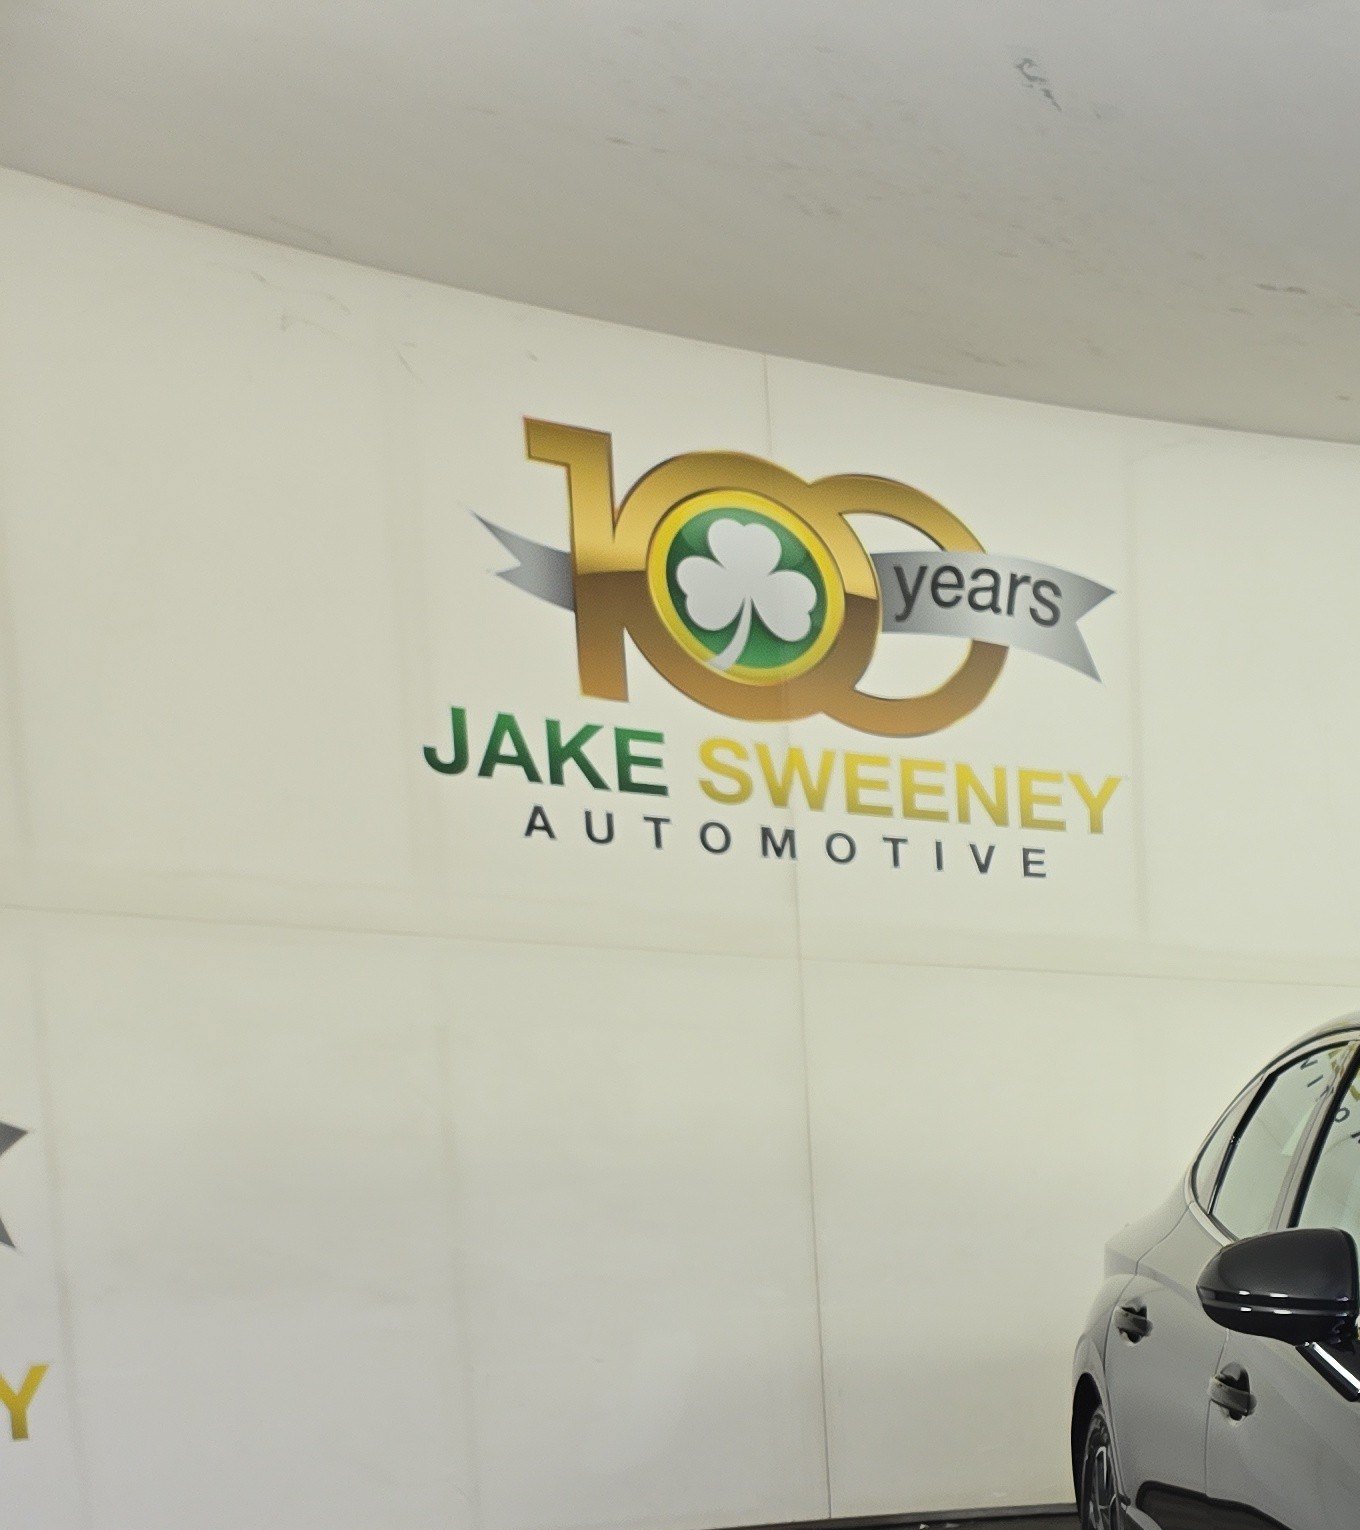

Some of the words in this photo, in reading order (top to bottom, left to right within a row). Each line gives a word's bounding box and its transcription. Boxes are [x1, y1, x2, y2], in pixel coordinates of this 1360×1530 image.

[522, 416, 1010, 738] 100
[892, 561, 1063, 628] years
[423, 705, 670, 797] JAKE
[698, 738, 1124, 835] SWEENEY
[523, 804, 1048, 879] AUTOMOTIVE
